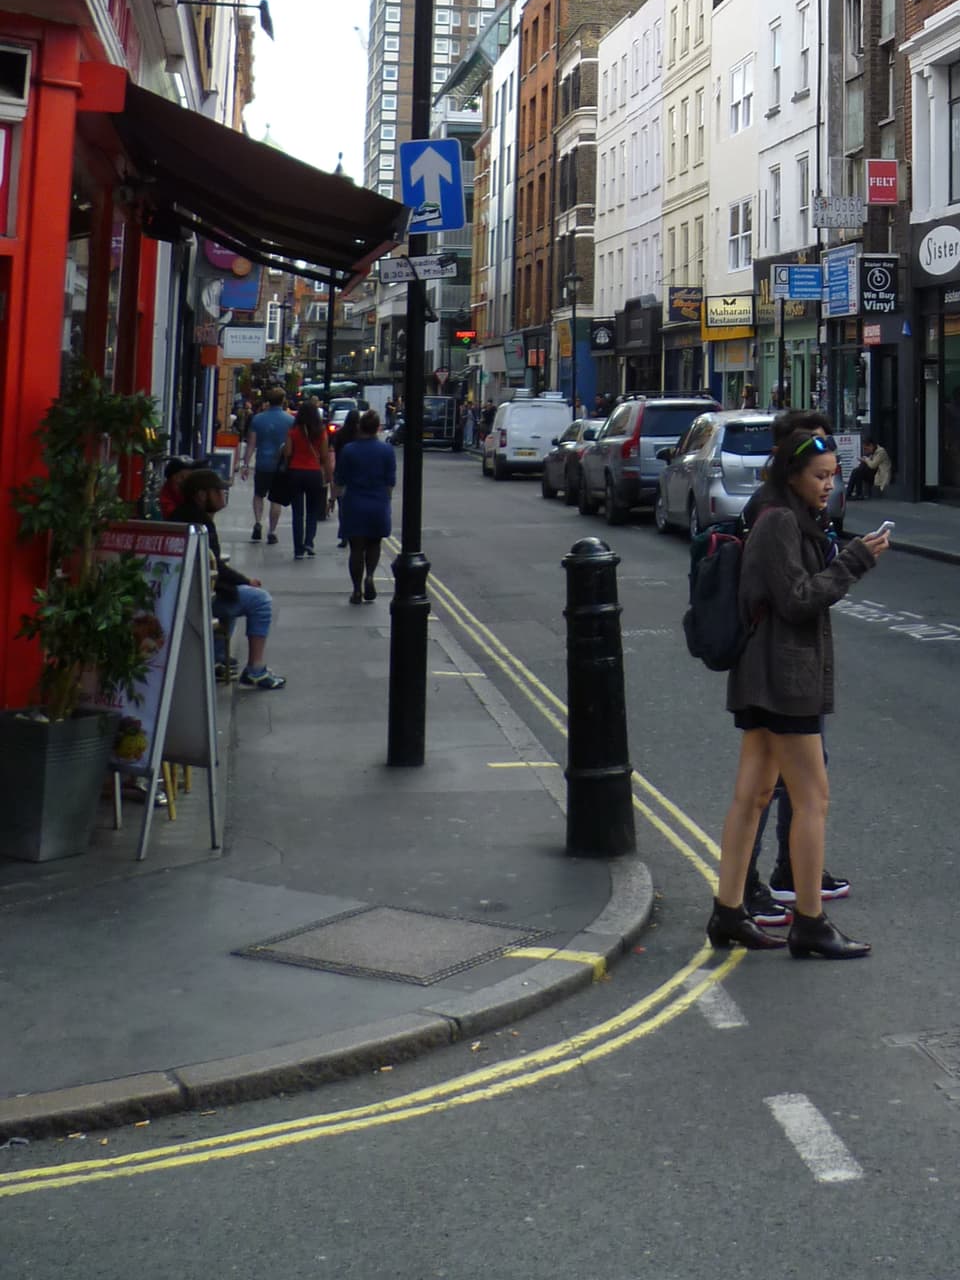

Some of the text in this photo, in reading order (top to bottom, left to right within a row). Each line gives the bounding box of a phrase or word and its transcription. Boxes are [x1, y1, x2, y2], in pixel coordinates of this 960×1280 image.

[869, 176, 896, 188] FELT
[926, 237, 959, 265] Sister
[864, 291, 896, 301] We Buy
[710, 307, 751, 316] Maharani
[864, 300, 895, 313] Vinyl
[710, 317, 751, 325] Restaurant
